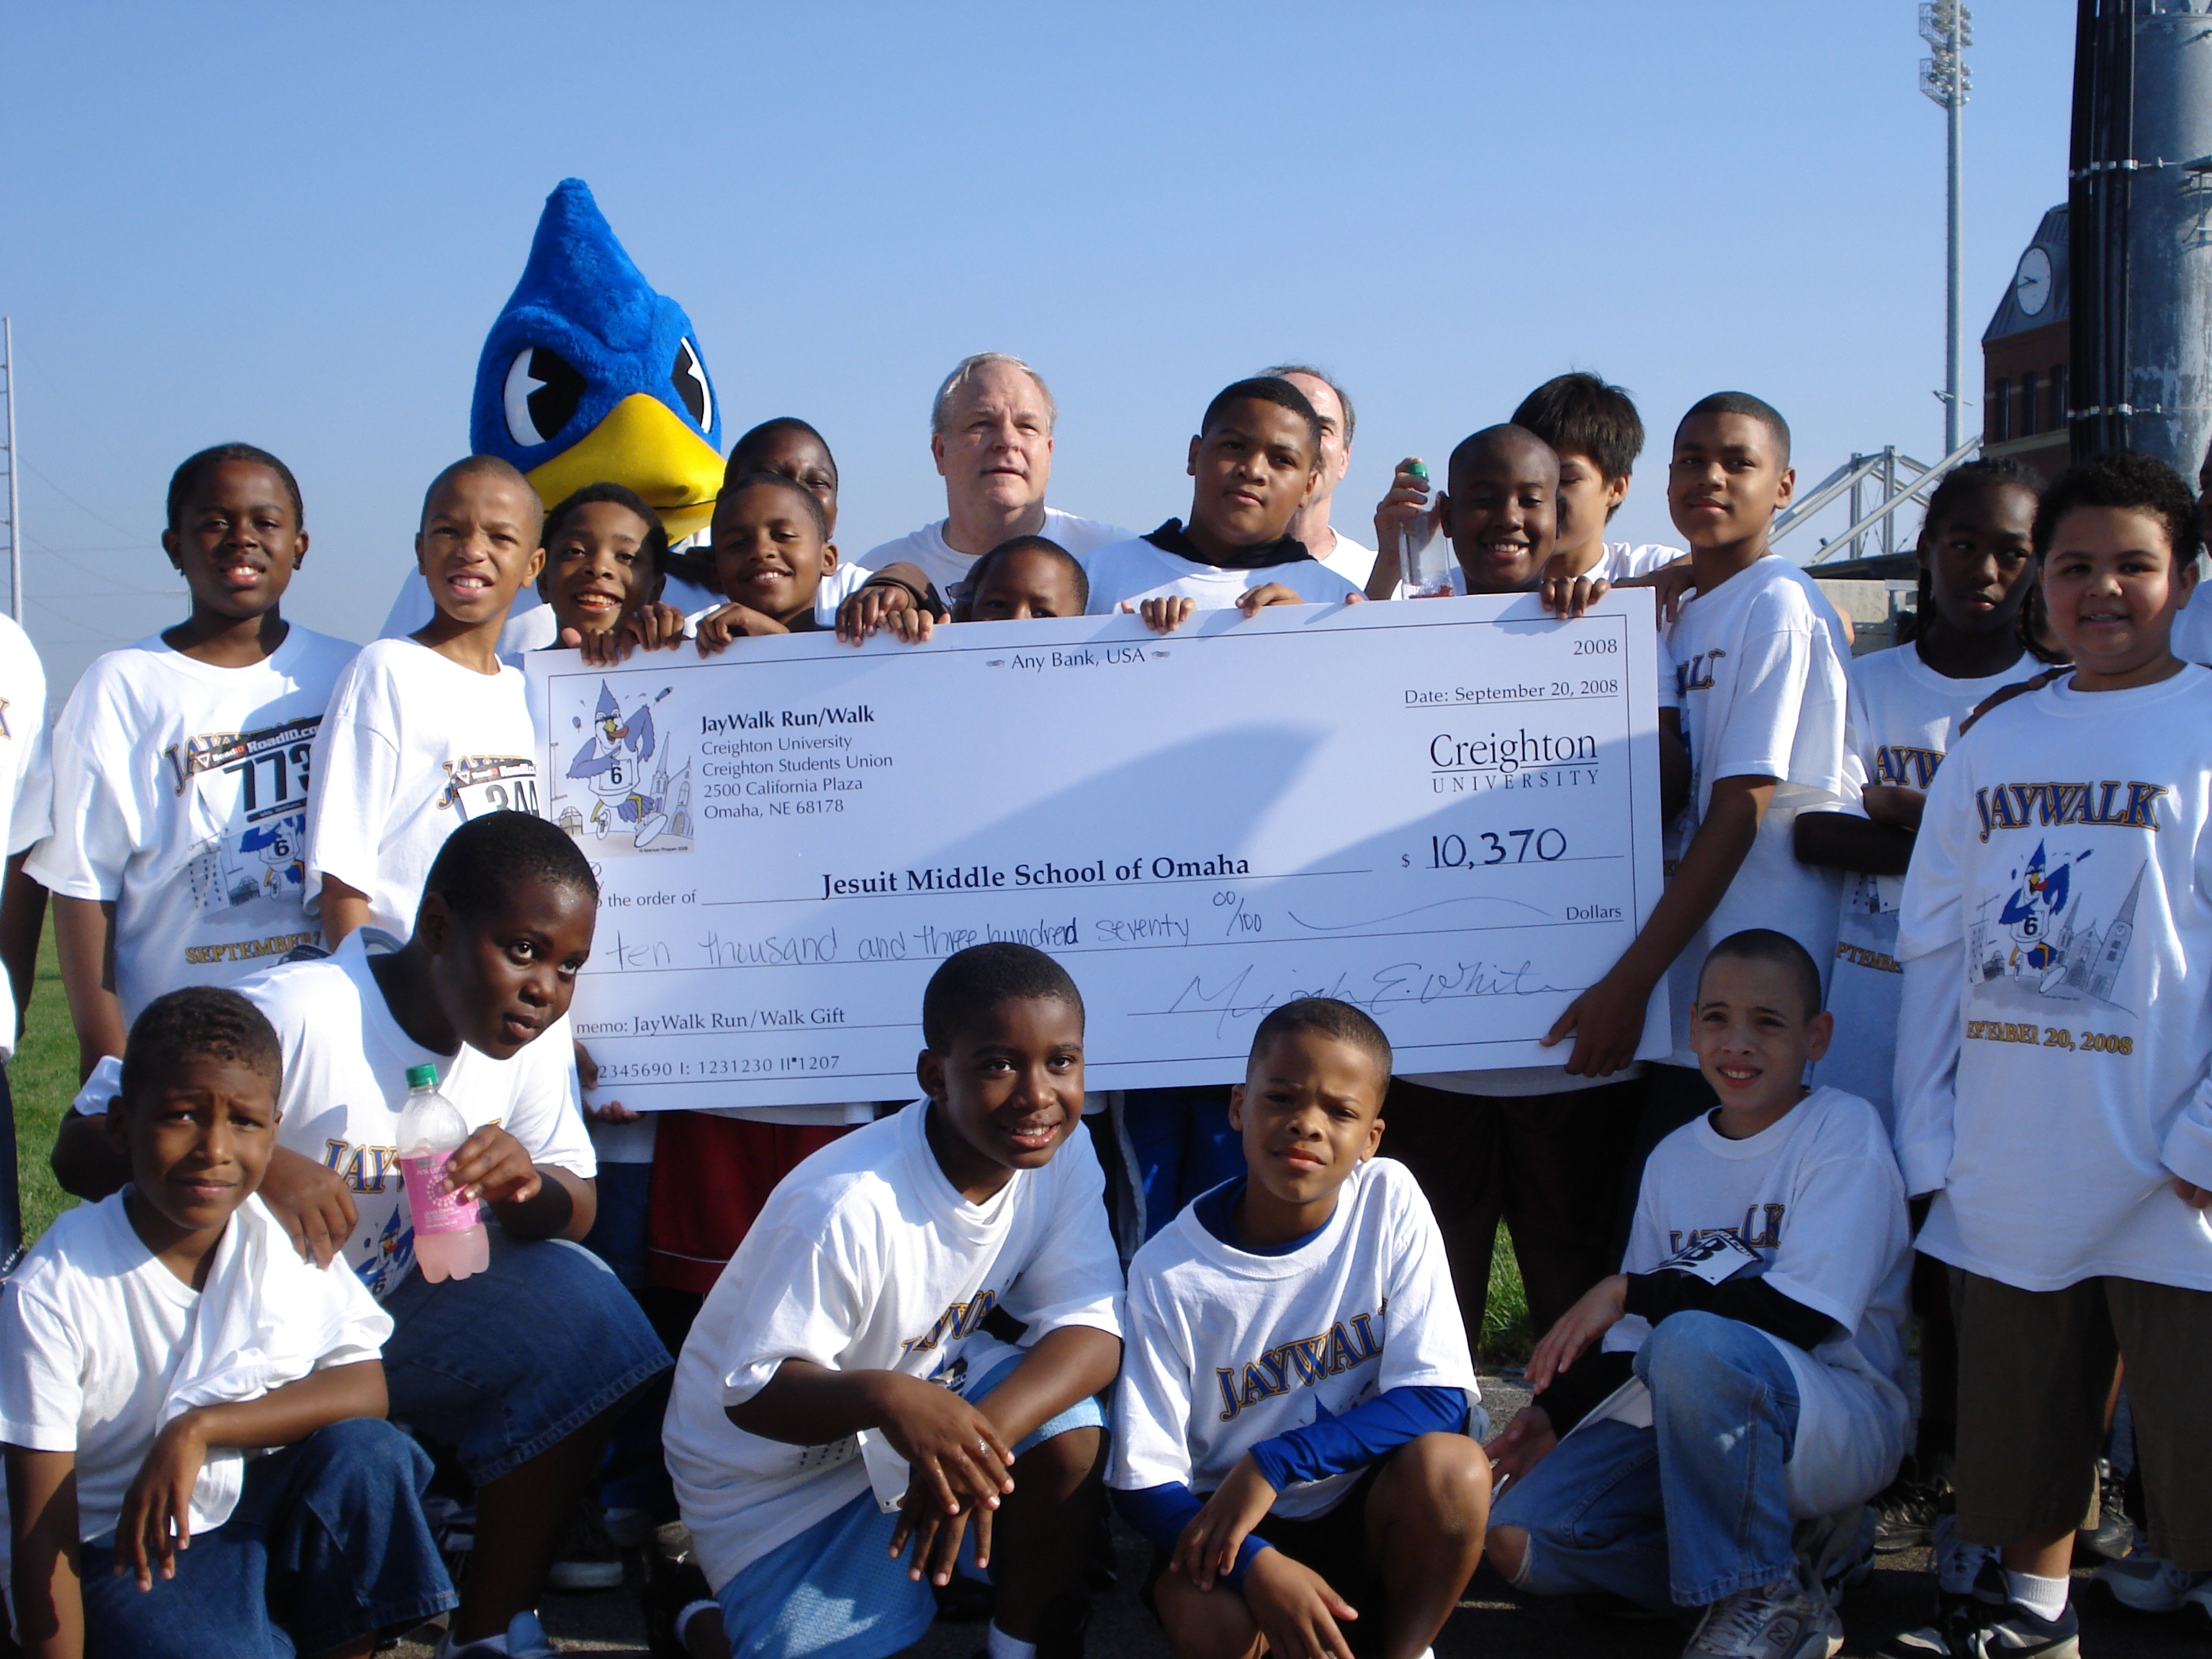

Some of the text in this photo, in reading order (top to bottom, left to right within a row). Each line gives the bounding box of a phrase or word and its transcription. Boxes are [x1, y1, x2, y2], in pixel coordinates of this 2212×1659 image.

[1573, 639, 1617, 655] 2008
[1012, 648, 1145, 673] Any Bank, USA
[1406, 679, 1619, 704] Date: September 20, 2008
[701, 705, 875, 736] JayWalk Run/Walk
[701, 734, 852, 757] Creighton University
[1430, 728, 1598, 773] Creighton
[611, 767, 622, 784] 6
[702, 754, 893, 779] Creighton Students Union
[704, 777, 863, 799] 2500 California Plaza
[1432, 770, 1599, 793] UNIVERSITY
[704, 799, 844, 819] Omaha, NE 68178
[1975, 781, 2169, 843] JAYWALK
[274, 838, 289, 856] 6
[1432, 828, 1567, 870] 10,370
[608, 854, 1250, 907] the order of Jesuit Middle School of Omaha
[1566, 904, 1622, 921] Dollars
[2023, 915, 2038, 935] 6
[606, 930, 670, 971] ten
[698, 927, 837, 966] thousand
[858, 927, 906, 962] and
[1096, 914, 1190, 947] seventy
[576, 1020, 628, 1034] memo:
[633, 1014, 706, 1036] JayWalk
[810, 1007, 845, 1025] Gift
[2044, 1028, 2075, 1052] 20,
[2080, 1032, 2134, 1056] 2008
[699, 1058, 772, 1074] 1231230
[1216, 1312, 1385, 1422] JAYWAL
